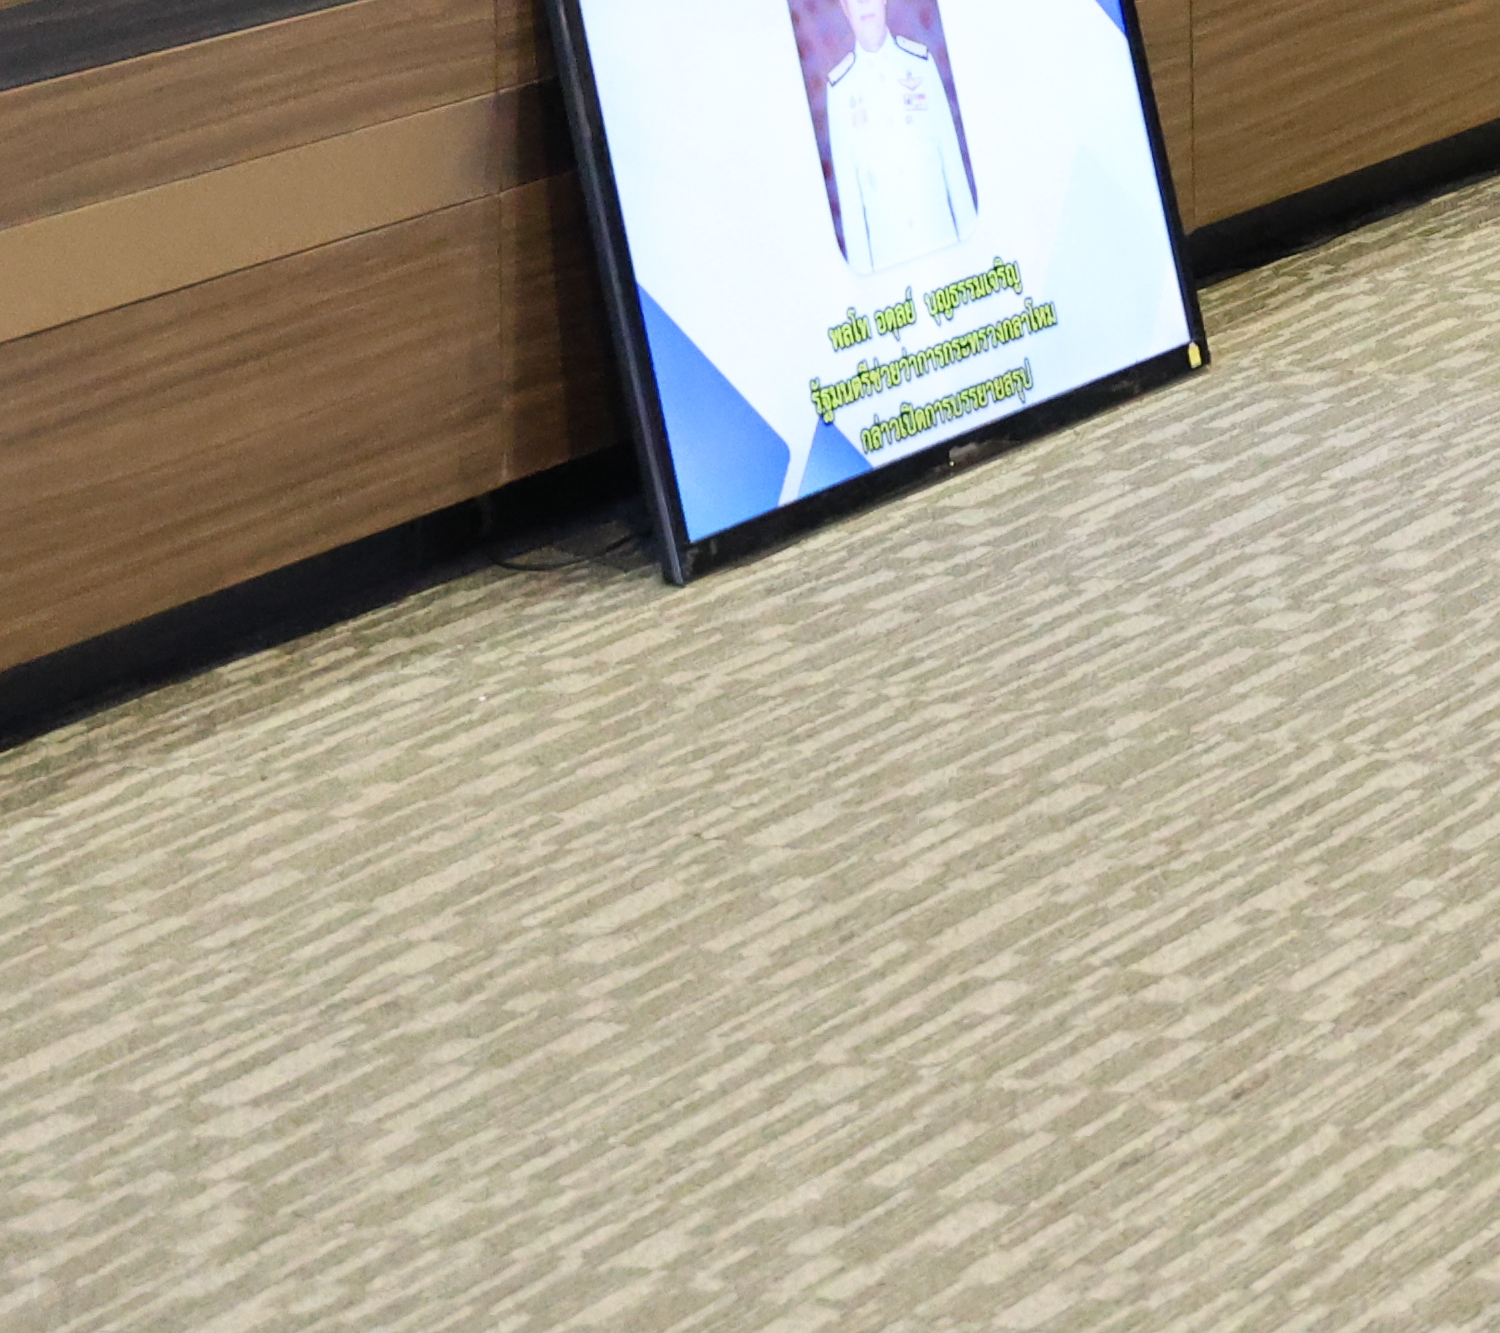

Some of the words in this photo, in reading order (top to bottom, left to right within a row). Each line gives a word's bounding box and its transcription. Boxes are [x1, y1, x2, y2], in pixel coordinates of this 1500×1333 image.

[828, 306, 872, 352] พลโท
[874, 286, 916, 342] อดุลย์
[924, 255, 1024, 327] บุญธรรมเจริญ
[810, 296, 1058, 425] รัฐมนตรีช่วยว่าการกระทรวงกลาโหม
[860, 357, 1034, 454] กล่าวเปิดการบรรยายสรุป
